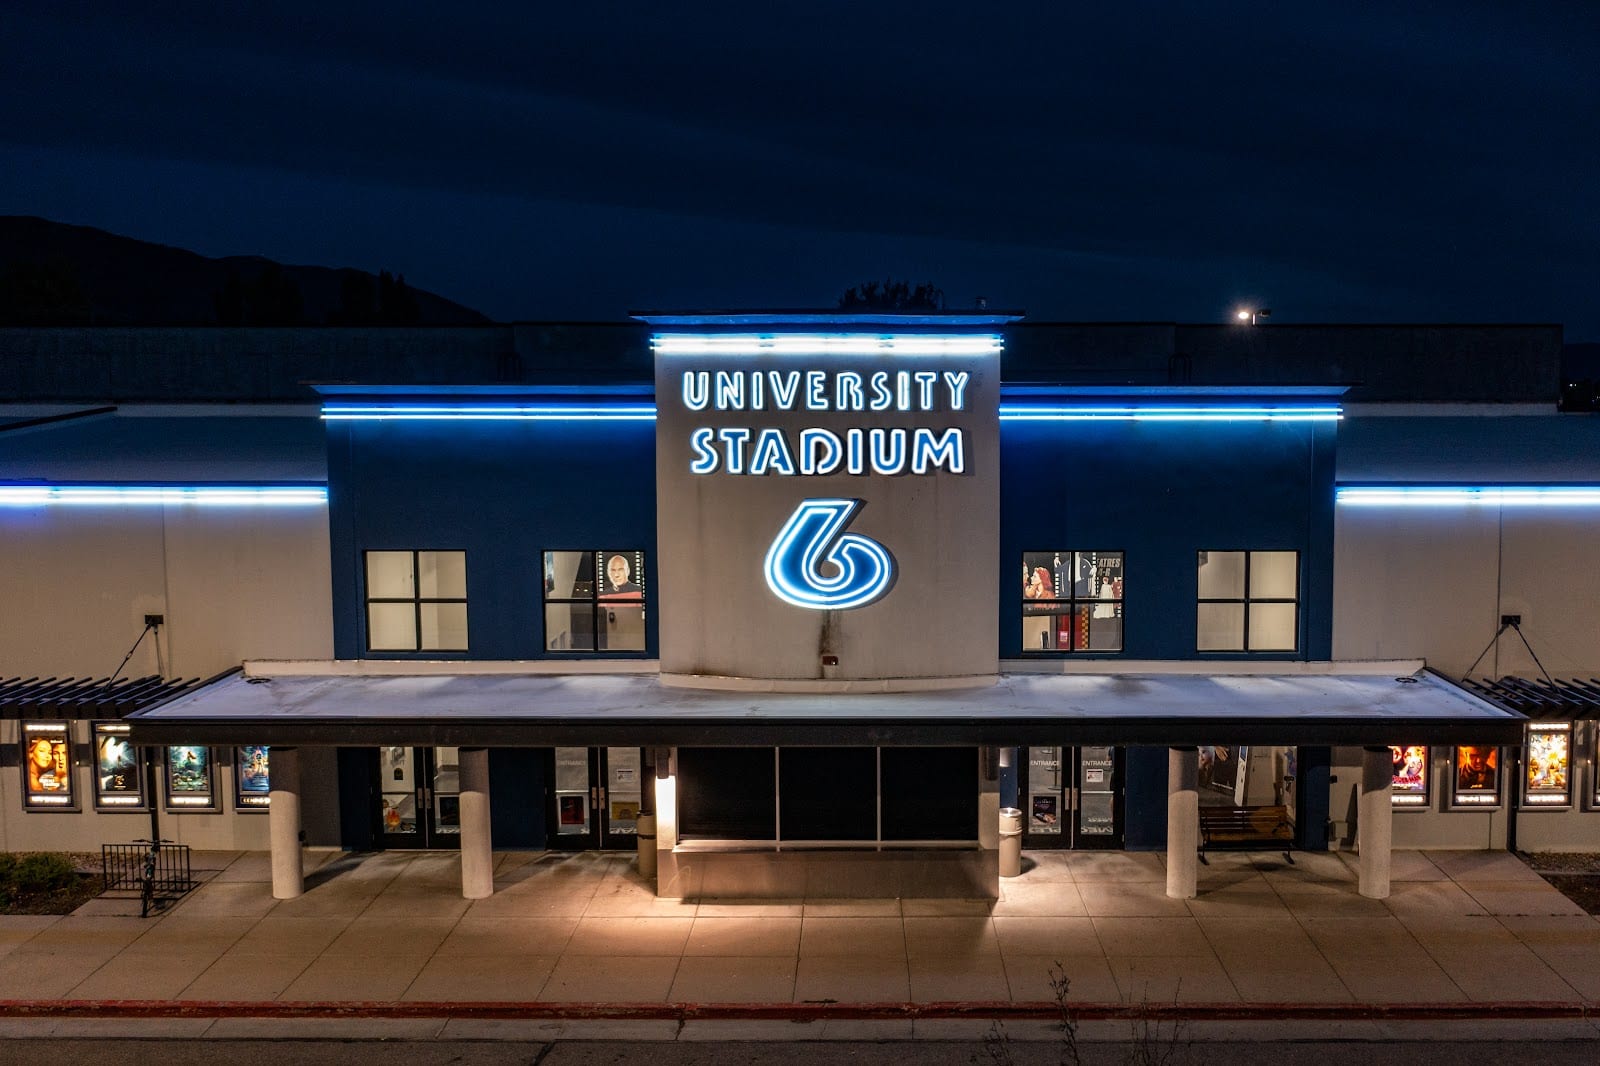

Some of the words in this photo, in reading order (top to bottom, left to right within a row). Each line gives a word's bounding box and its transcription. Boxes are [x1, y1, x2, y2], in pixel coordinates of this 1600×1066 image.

[682, 370, 969, 410] UNIVERSITY
[690, 427, 964, 475] STADIUM
[763, 497, 893, 610] 6
